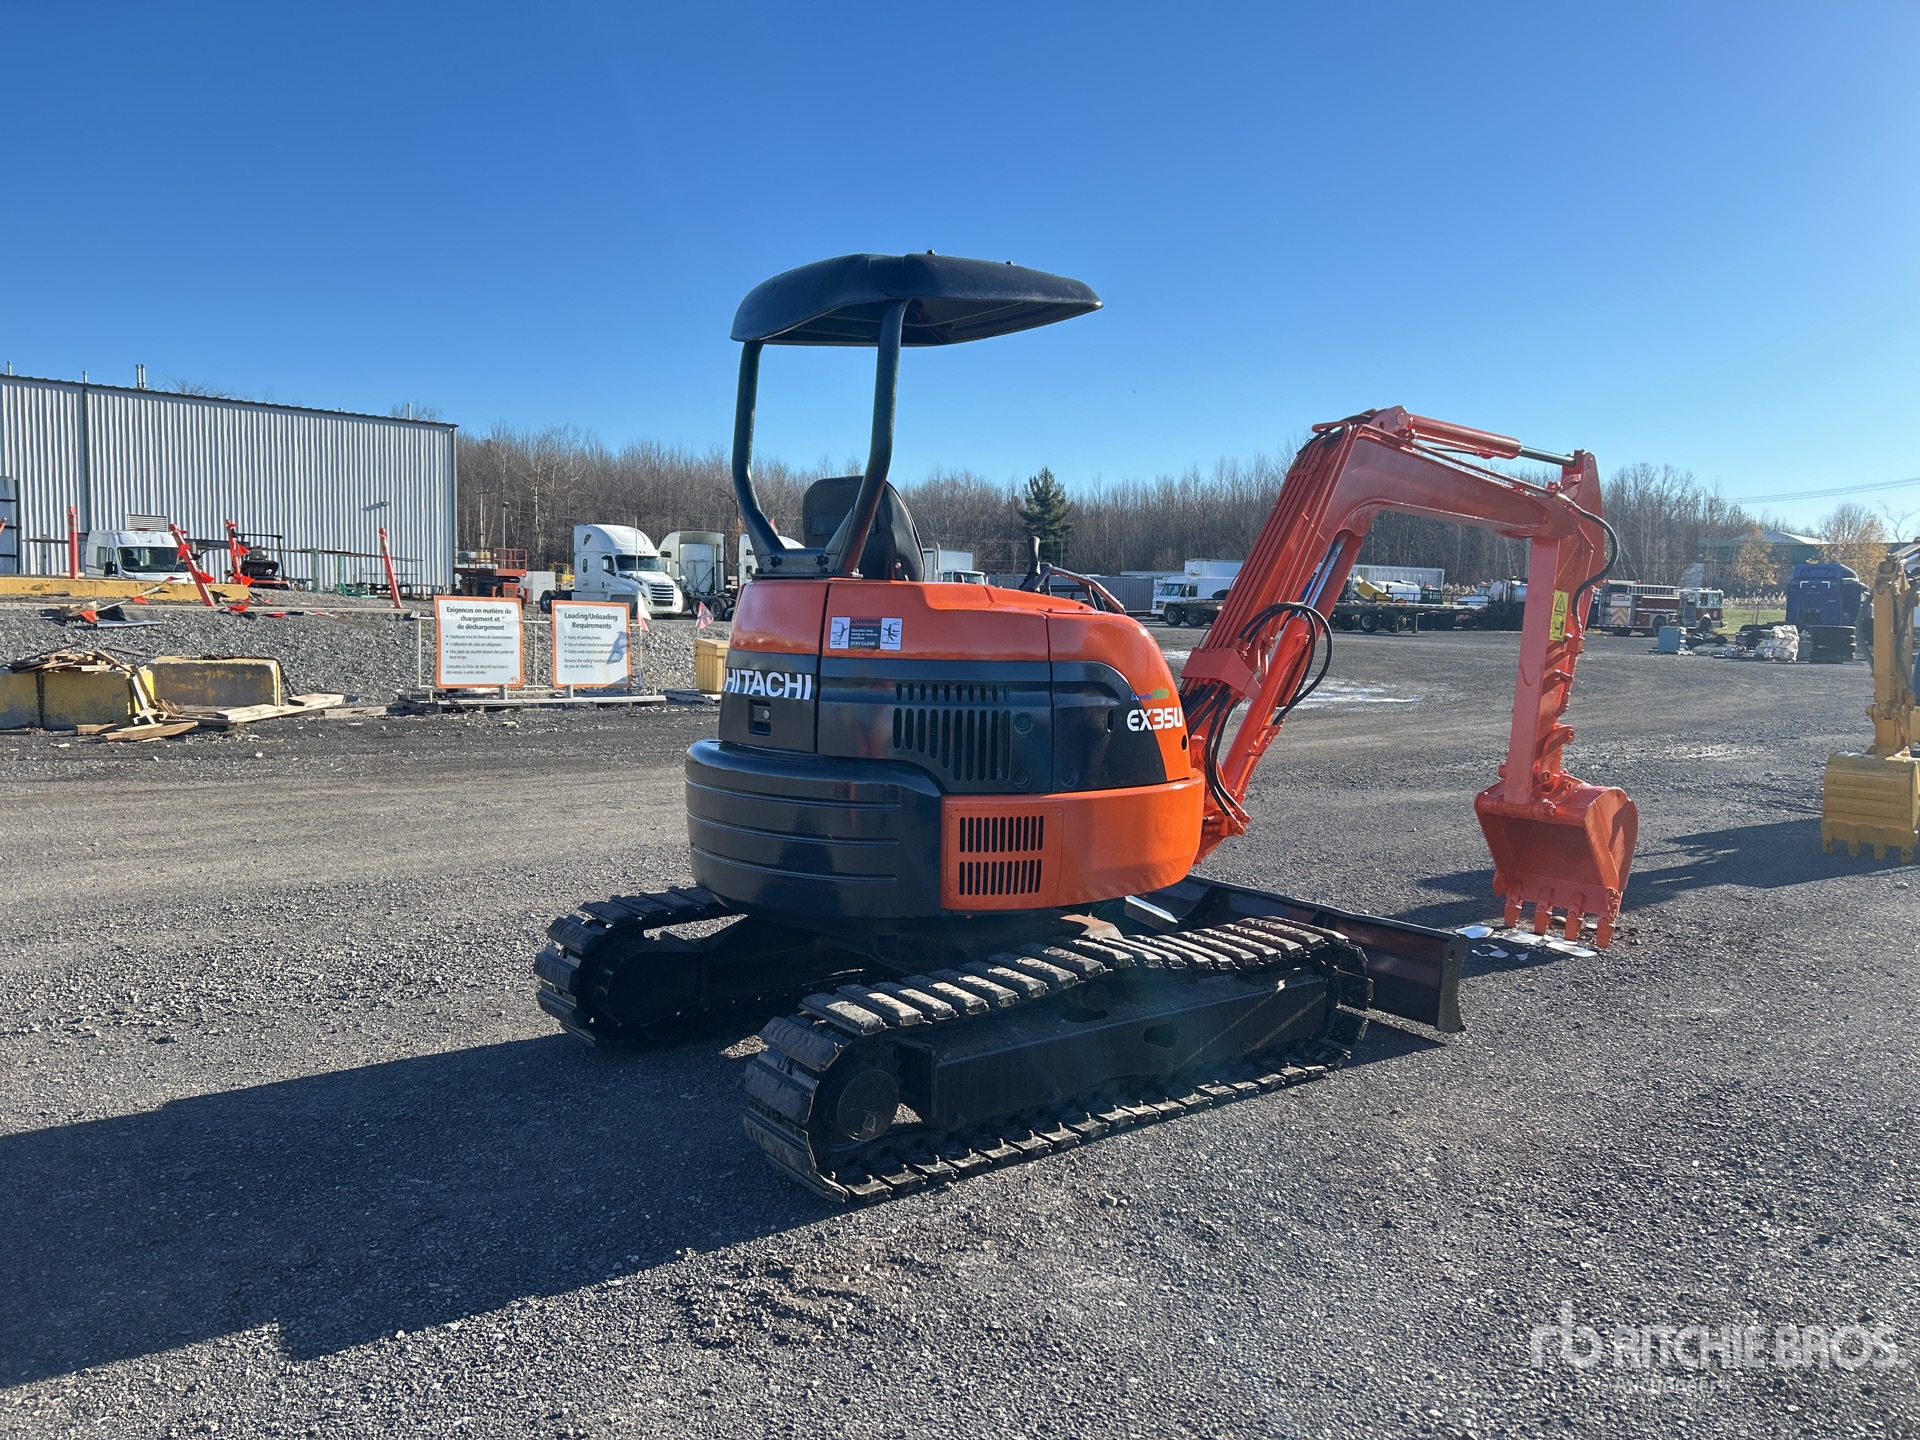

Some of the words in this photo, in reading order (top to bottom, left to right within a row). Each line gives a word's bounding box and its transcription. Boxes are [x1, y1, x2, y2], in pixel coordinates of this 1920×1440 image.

[446, 606, 474, 614] Exigences
[564, 612, 618, 622] Loading/Unloading
[572, 622, 612, 630] Requirements
[723, 668, 812, 700] HITACHI
[1126, 706, 1183, 732] EX35U
